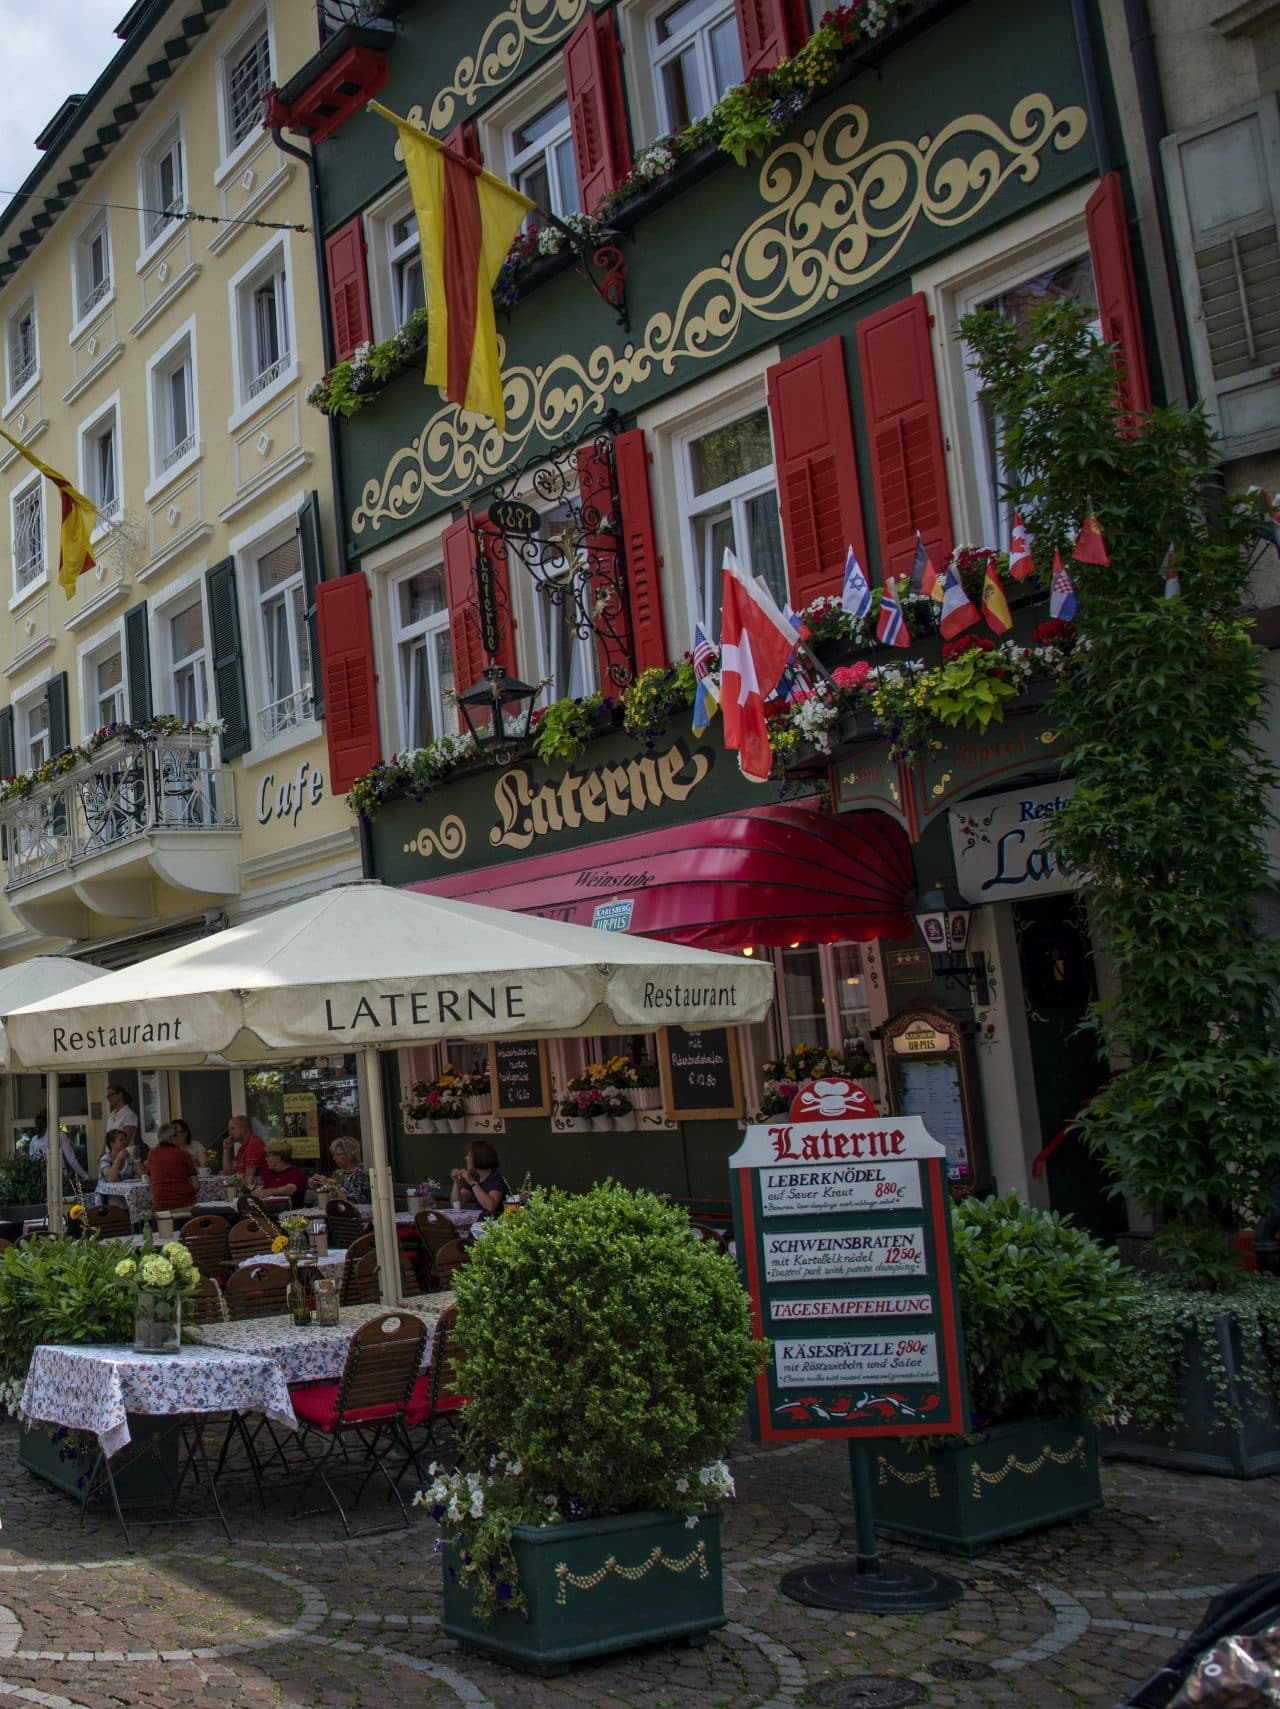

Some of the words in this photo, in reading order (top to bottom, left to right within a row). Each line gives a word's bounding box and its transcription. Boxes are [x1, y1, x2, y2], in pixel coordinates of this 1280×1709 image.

[480, 556, 496, 652] Laterne
[489, 745, 709, 850] Laterne
[573, 870, 655, 888] Weinstube
[595, 903, 632, 917] KARLSBERG
[643, 982, 737, 1009] Restaurant
[325, 985, 525, 1031] LATERNE
[53, 1017, 182, 1052] Restaurant
[768, 1126, 906, 1162] Laterne
[767, 1167, 886, 1187] LEBERKNÖDEL
[768, 1191, 785, 1201] auf
[787, 1187, 819, 1199] Sauer
[822, 1186, 853, 1198] Kraut
[770, 1233, 916, 1254] SCHWEINSBRATEN
[771, 1255, 790, 1267] mit
[792, 1251, 873, 1266] Kartoffelknödel
[772, 1298, 931, 1318] TAGESEMPFEHLUNG
[781, 1341, 895, 1360] KÄSESPÄTZLE
[783, 1362, 800, 1373] mit
[866, 1358, 887, 1369] und
[889, 1356, 923, 1369] Salat
